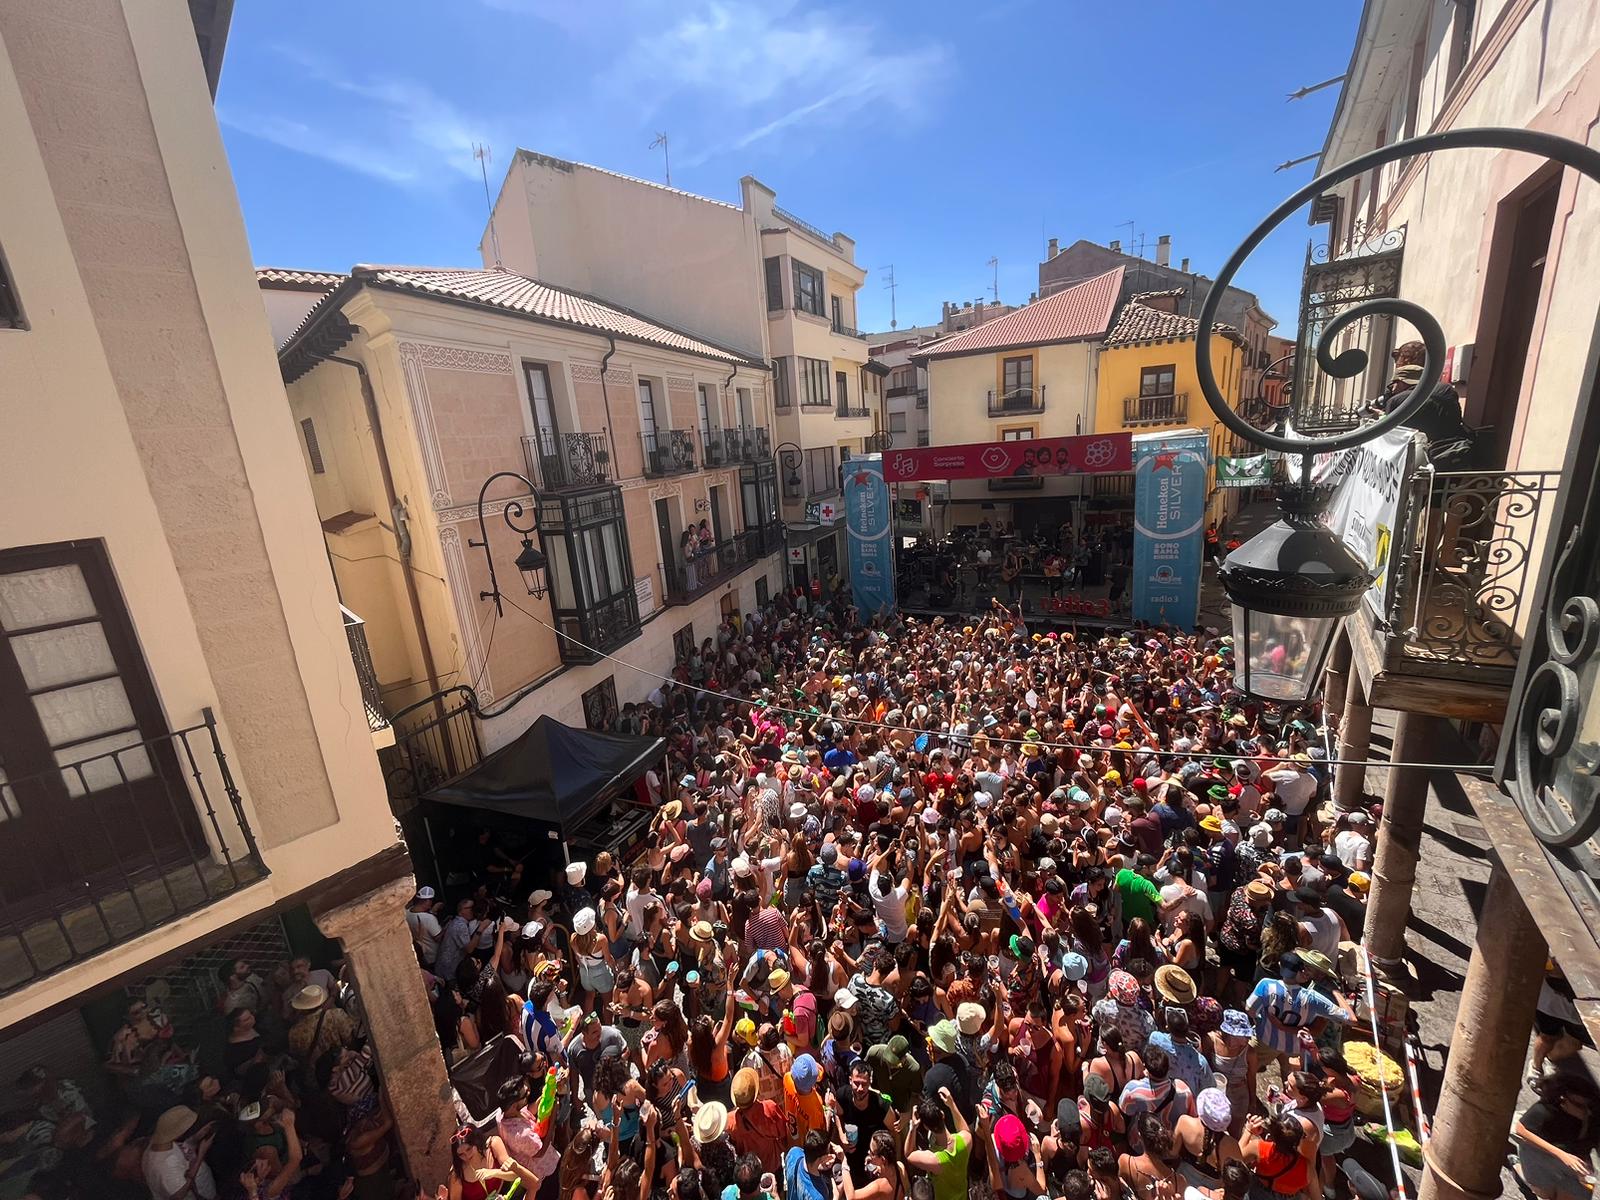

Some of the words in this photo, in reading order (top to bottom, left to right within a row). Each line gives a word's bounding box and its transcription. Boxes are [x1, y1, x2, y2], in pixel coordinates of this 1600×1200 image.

[867, 481, 875, 526] SILVER
[1157, 477, 1169, 528] Heineken
[1170, 464, 1182, 520] SILVER
